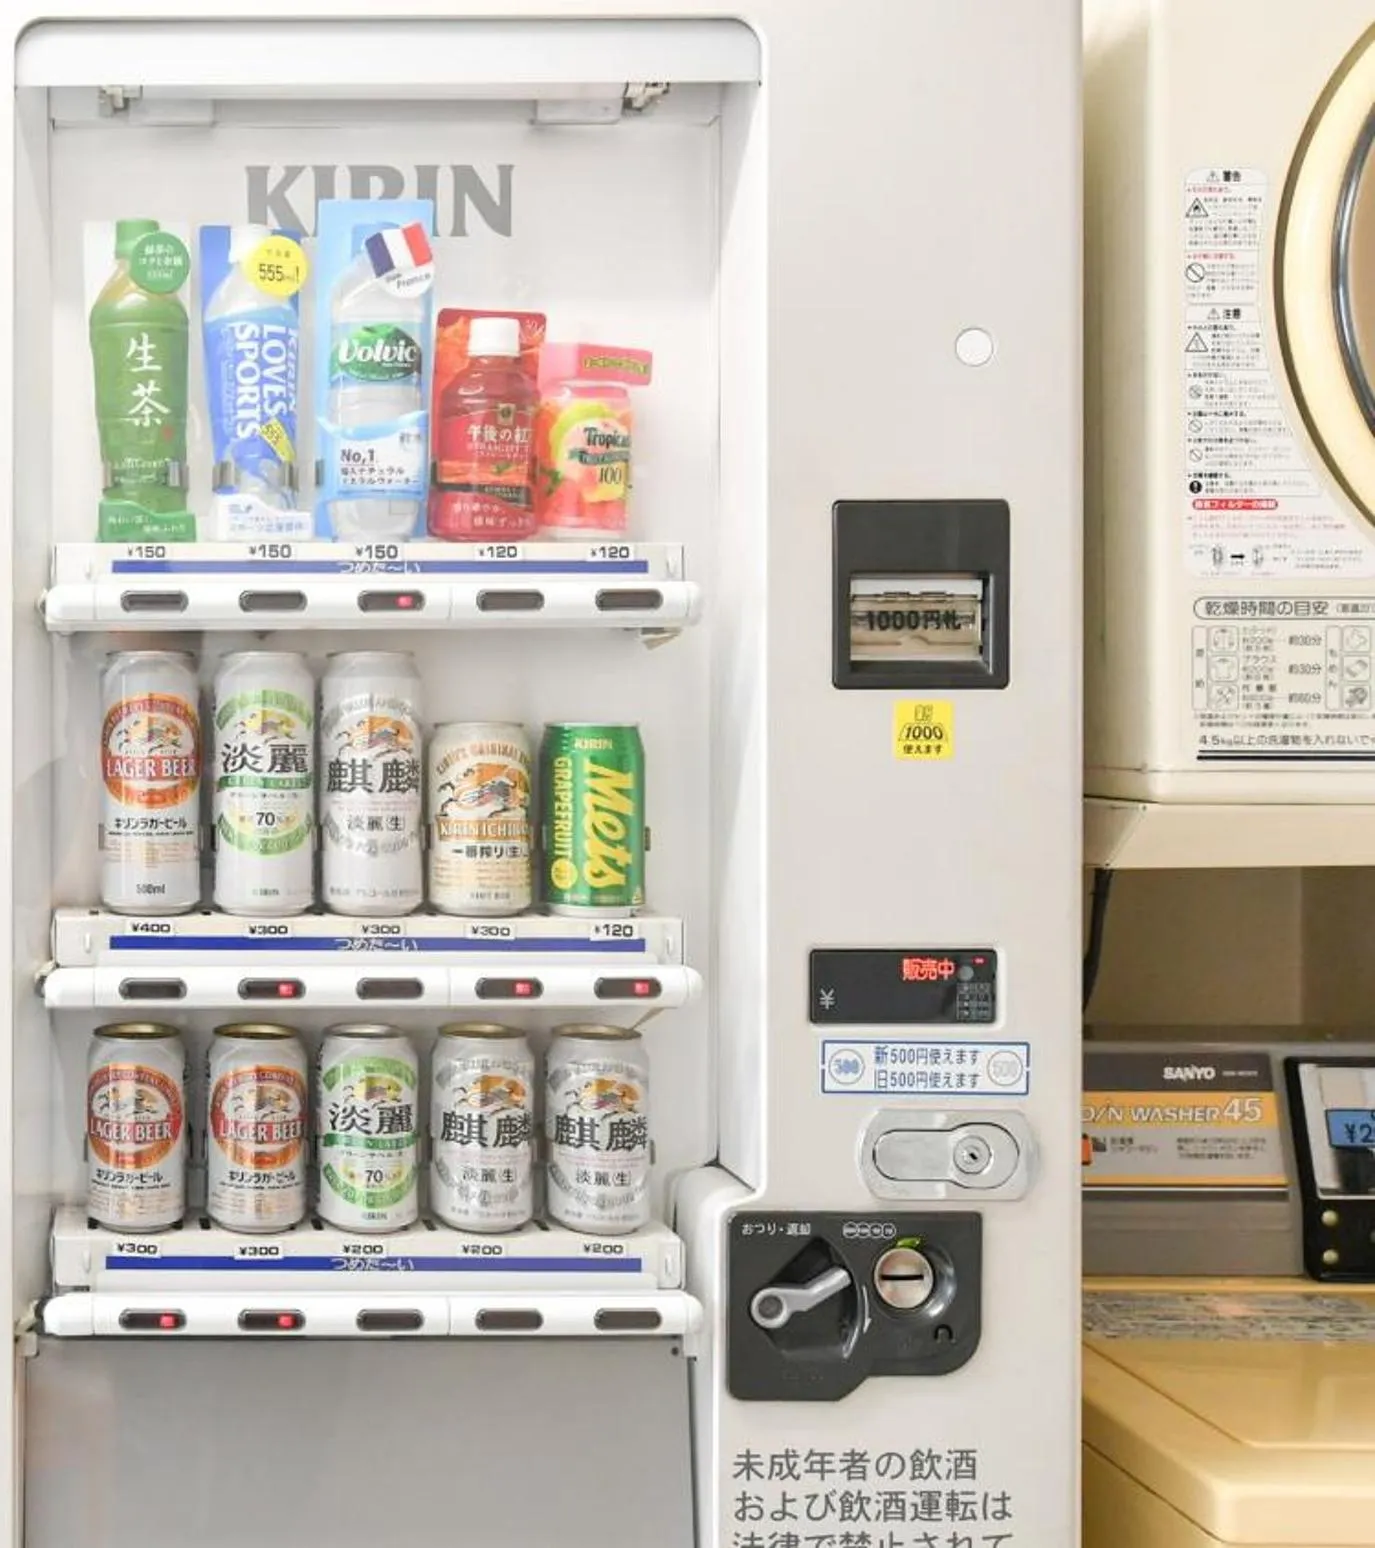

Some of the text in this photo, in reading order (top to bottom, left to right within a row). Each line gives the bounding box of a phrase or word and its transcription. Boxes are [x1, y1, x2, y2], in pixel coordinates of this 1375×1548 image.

[338, 339, 418, 363] Volvic
[126, 332, 173, 428] 生茶
[262, 323, 288, 418] LOVES
[233, 322, 262, 439] SPORTS
[467, 424, 532, 443] 午後の紅
[127, 545, 166, 559] ¥150
[249, 544, 292, 559] ¥150
[355, 545, 399, 559] ¥150
[479, 546, 518, 559] ¥120
[590, 546, 630, 559] ¥120
[1204, 600, 1330, 616] 乾燥時間の目安
[866, 609, 962, 631] 1000円札
[905, 725, 944, 741] 1000
[106, 757, 197, 778] LAGER BEER
[223, 743, 310, 774] 淡麗
[327, 758, 420, 794] 麒麟
[552, 757, 574, 857] GRAPEFRUIT
[114, 817, 188, 831] キリンラガービール
[582, 757, 635, 889] Mets
[131, 922, 171, 934] ¥400
[248, 924, 288, 935] ¥300
[361, 924, 401, 935] ¥300
[471, 925, 511, 937] ¥300
[593, 923, 634, 938] ¥120
[902, 957, 956, 981] 販売中
[819, 987, 836, 1010] ¥
[874, 1045, 980, 1066] 新500円使えます
[874, 1069, 982, 1090] 旧500円使えます
[1163, 1066, 1217, 1082] SANYO
[328, 1101, 414, 1136] 淡麗
[1131, 1097, 1263, 1123] WASHER 45
[90, 1120, 172, 1141] LAGER BEER
[219, 1121, 268, 1141] LAGER
[441, 1110, 532, 1149] 麒麟
[555, 1113, 649, 1153] 麒麟
[95, 1168, 164, 1184] キリンラガービール
[741, 1222, 811, 1236] おつり・返却
[117, 1242, 158, 1256] ¥300
[239, 1245, 279, 1257] ¥300
[343, 1244, 384, 1255] ¥200
[462, 1244, 503, 1256] ¥200
[583, 1243, 624, 1256] ¥200
[732, 1447, 978, 1482] 未成年者の飲酒
[732, 1488, 1014, 1523] および飲酒運転は
